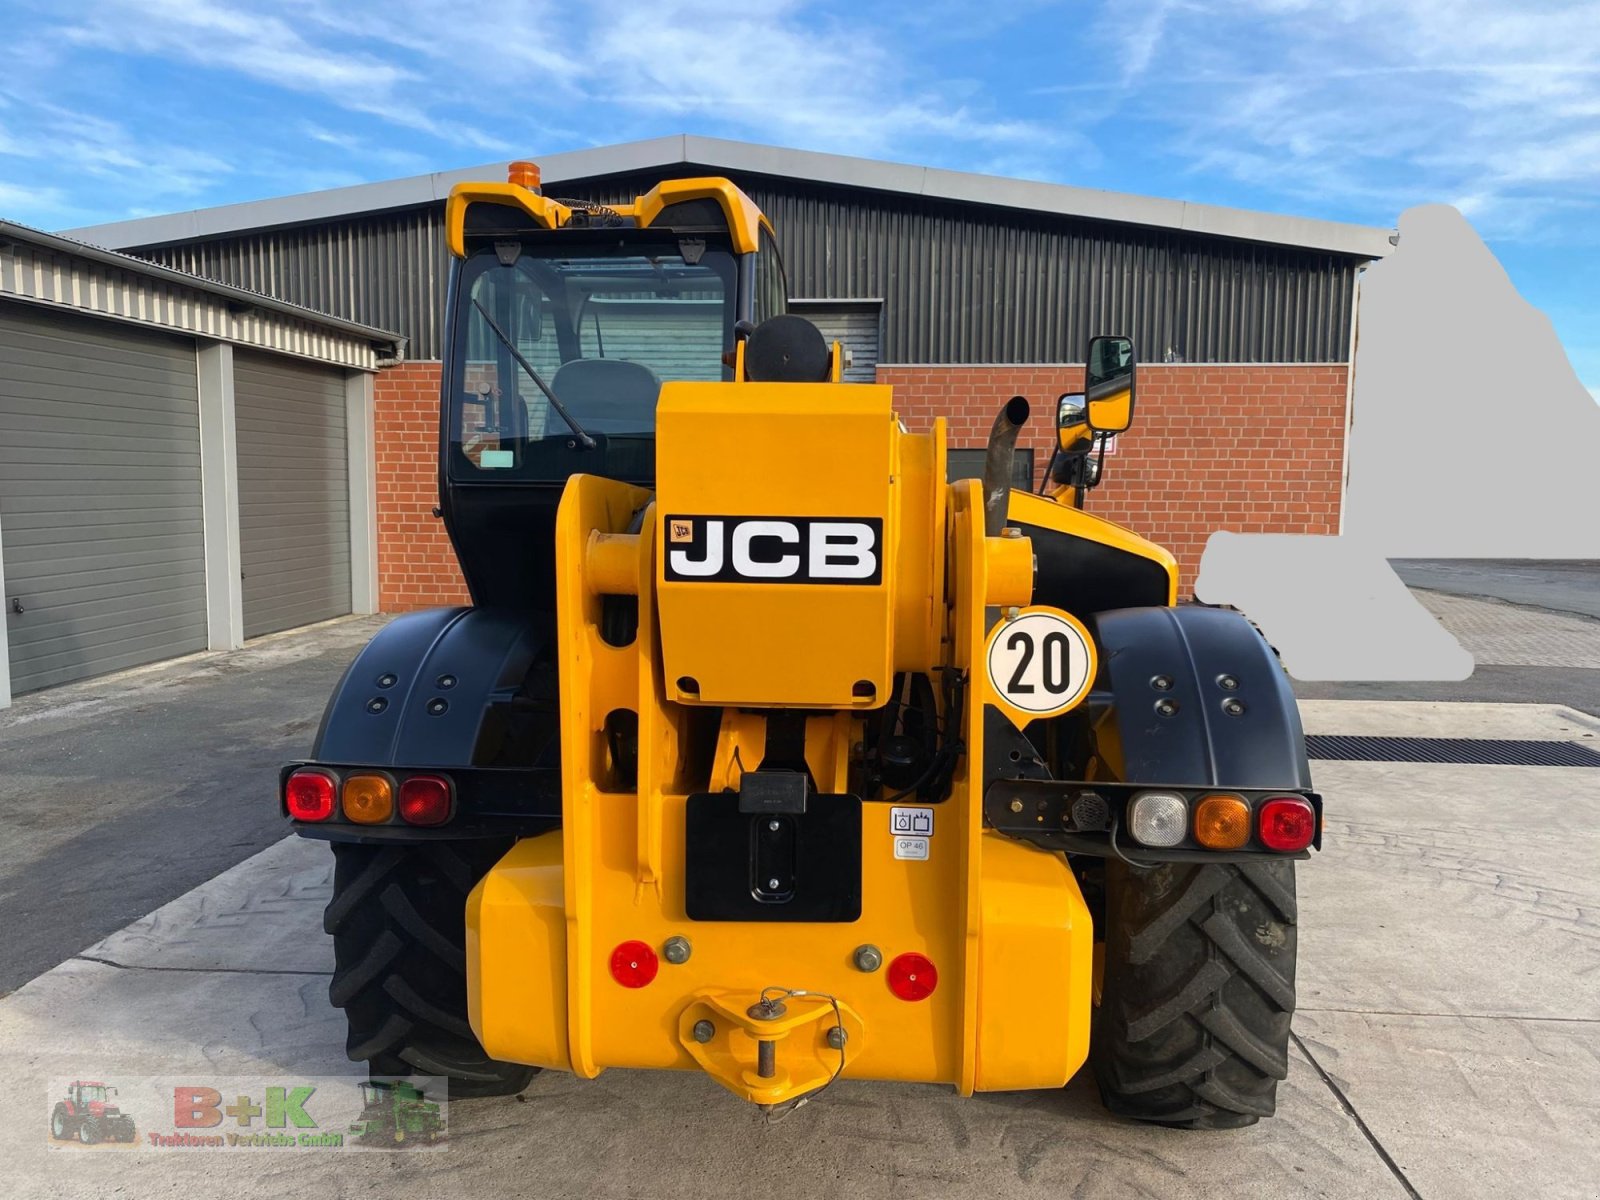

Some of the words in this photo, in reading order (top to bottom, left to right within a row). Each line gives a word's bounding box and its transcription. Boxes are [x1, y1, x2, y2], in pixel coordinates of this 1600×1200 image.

[670, 520, 877, 578] JCB
[1007, 631, 1070, 694] 20
[900, 841, 912, 849] OP
[914, 842, 924, 850] 46
